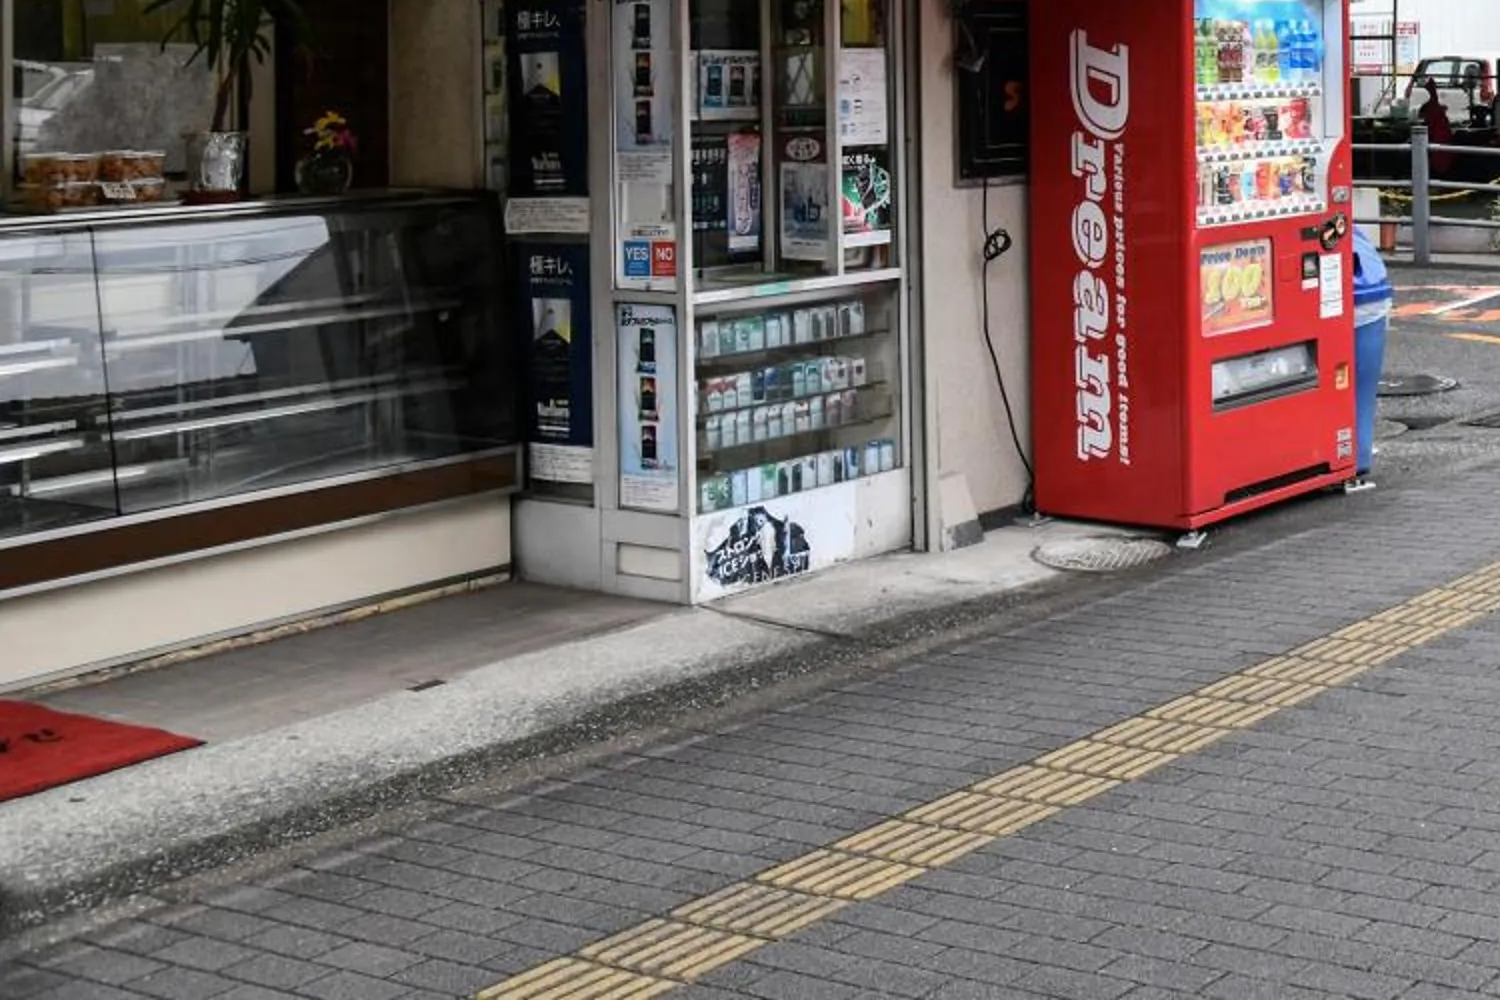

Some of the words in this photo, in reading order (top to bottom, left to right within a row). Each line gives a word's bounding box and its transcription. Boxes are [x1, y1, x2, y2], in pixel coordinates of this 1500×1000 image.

[624, 245, 649, 261] YES
[656, 245, 673, 261] NO
[1068, 27, 1131, 461] Dream
[1201, 251, 1232, 264] Price
[1234, 245, 1266, 259] Down
[1115, 294, 1128, 329] for
[1116, 333, 1130, 388] good
